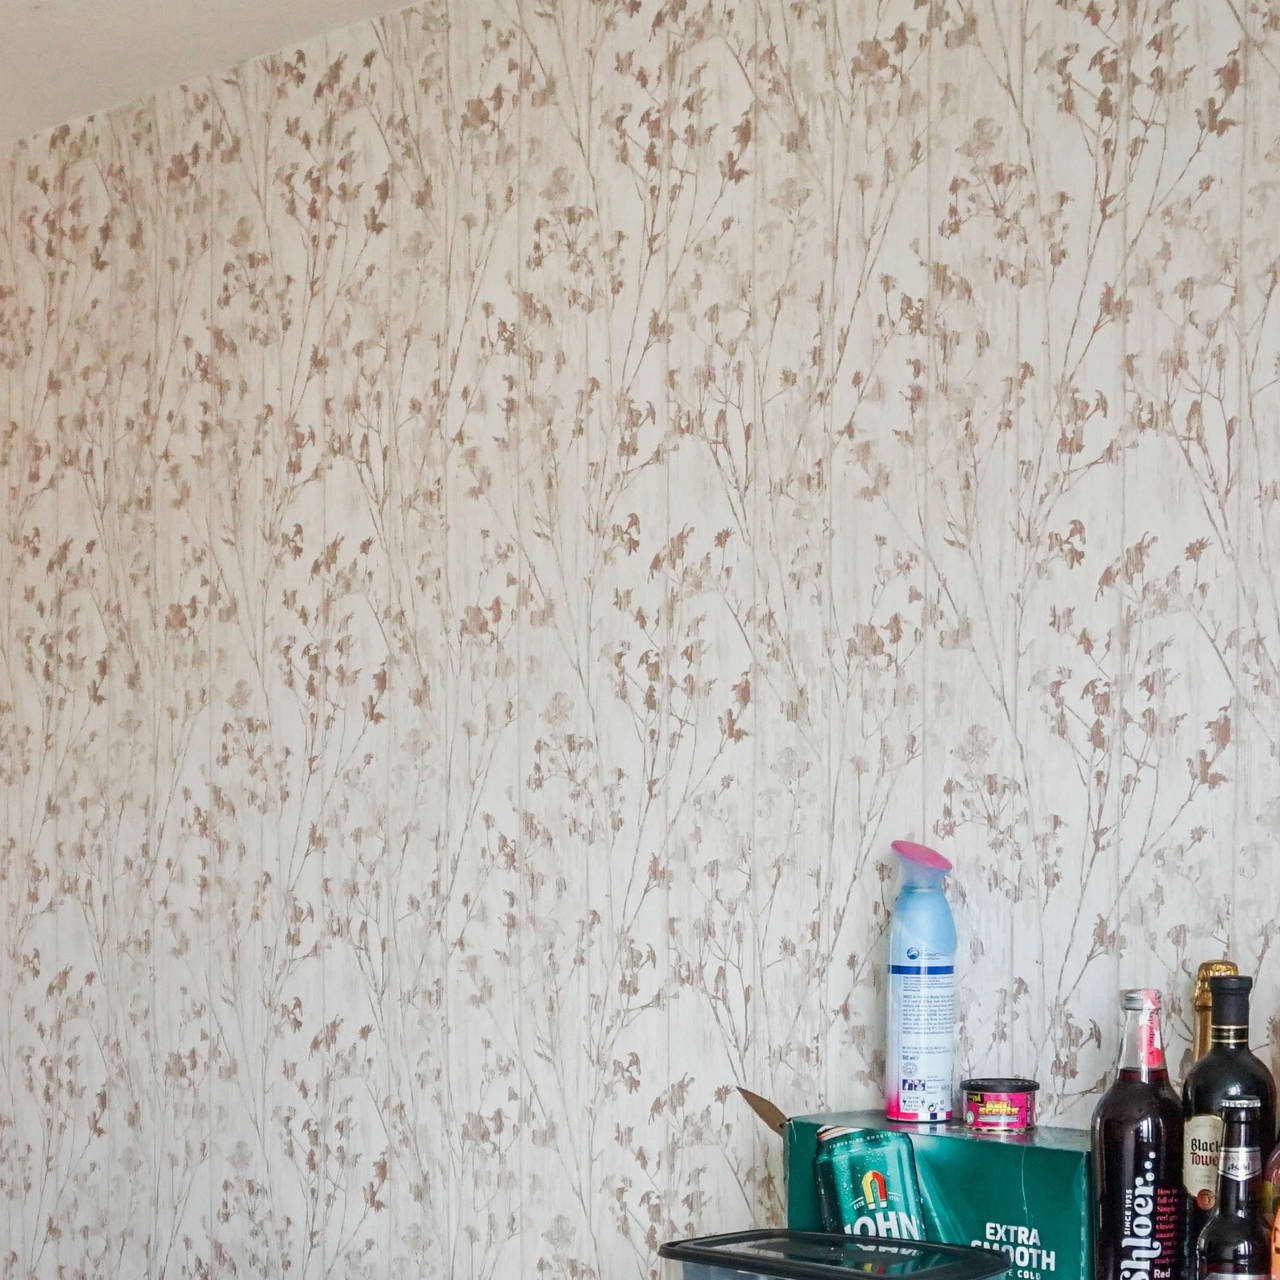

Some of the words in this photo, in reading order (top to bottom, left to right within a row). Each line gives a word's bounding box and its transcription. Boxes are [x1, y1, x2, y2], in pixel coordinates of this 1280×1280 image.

[1190, 1152, 1219, 1166] Towe
[1124, 1210, 1132, 1235] SINCE
[985, 1222, 1040, 1246] EXTRA
[1017, 1269, 1041, 1280] COLD
[1154, 1269, 1171, 1278] Red
